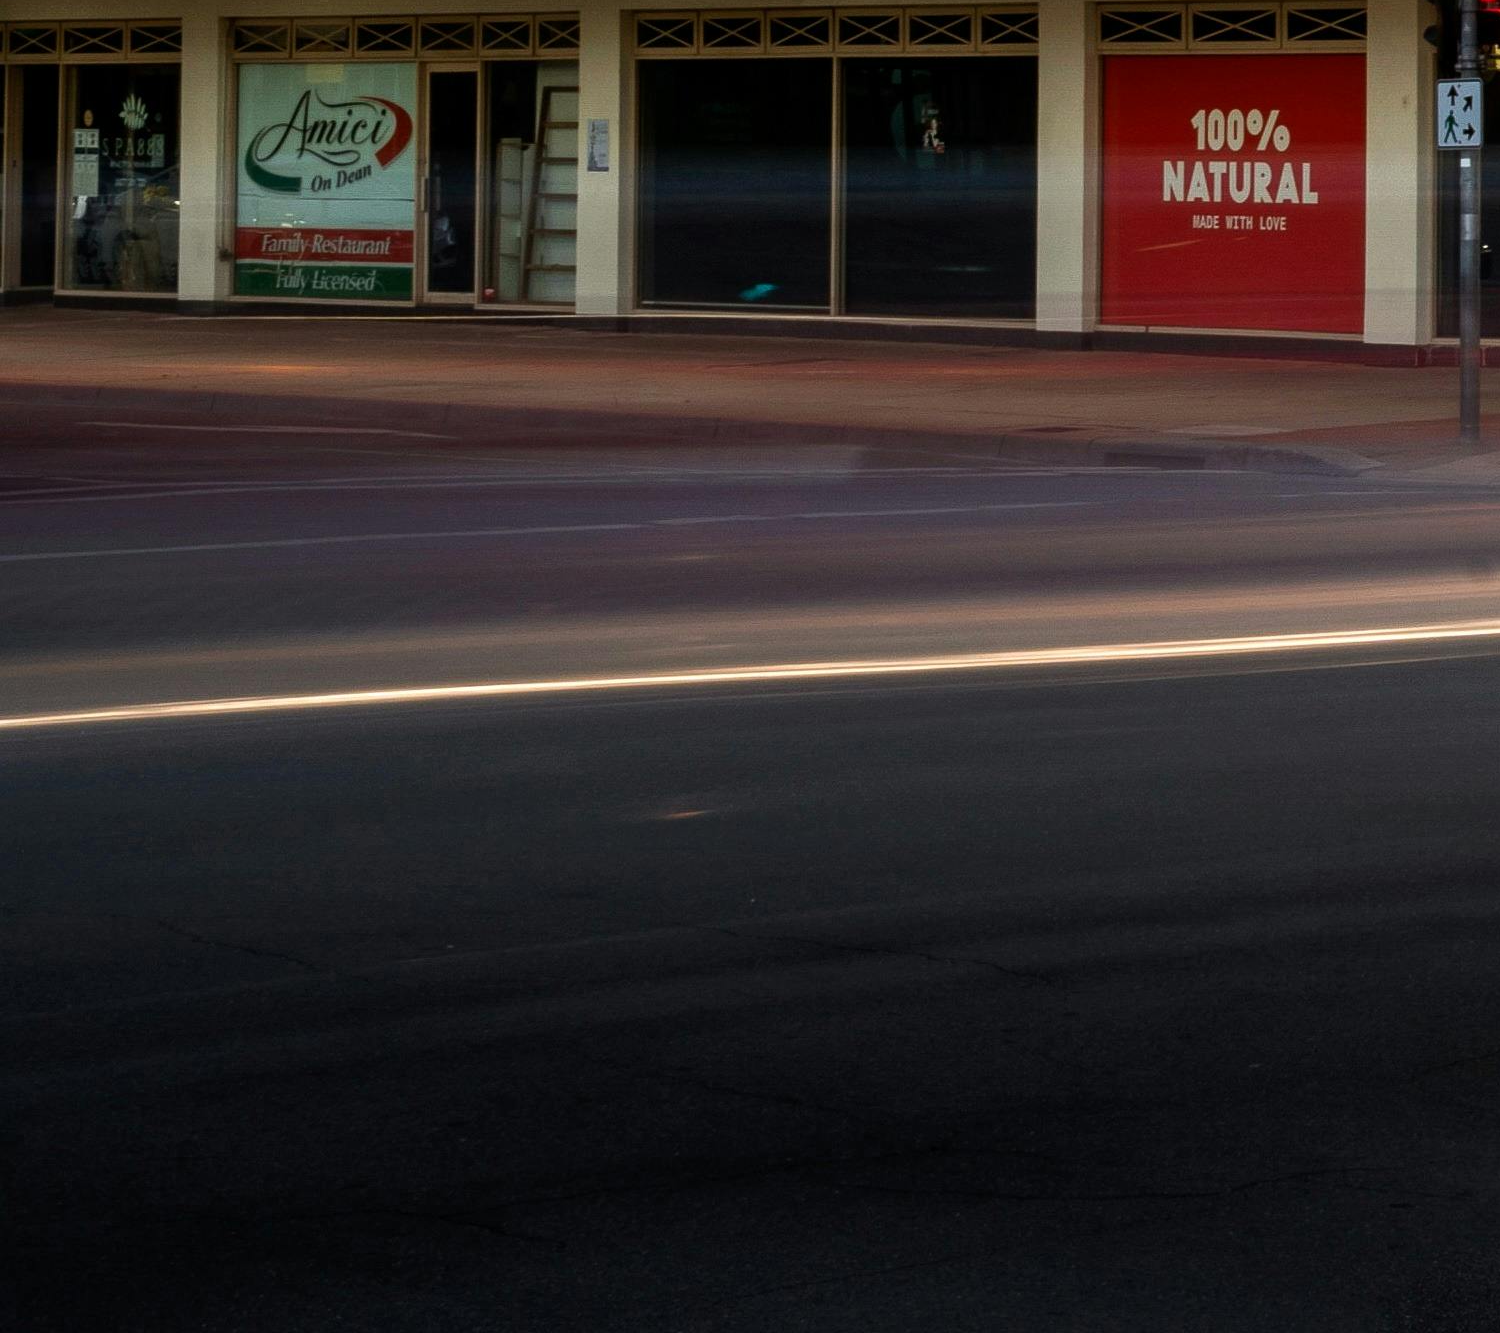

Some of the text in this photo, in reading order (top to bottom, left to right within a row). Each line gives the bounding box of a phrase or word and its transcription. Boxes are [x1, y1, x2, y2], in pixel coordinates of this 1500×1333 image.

[255, 90, 390, 162] Amici
[1190, 108, 1291, 152] 100%
[310, 164, 372, 192] On Dean
[1163, 160, 1319, 204] NATURAL
[1193, 215, 1287, 231] MADE WITH LOVE
[262, 233, 391, 259] Family Restaurant
[276, 265, 377, 292] Fully Licensed
